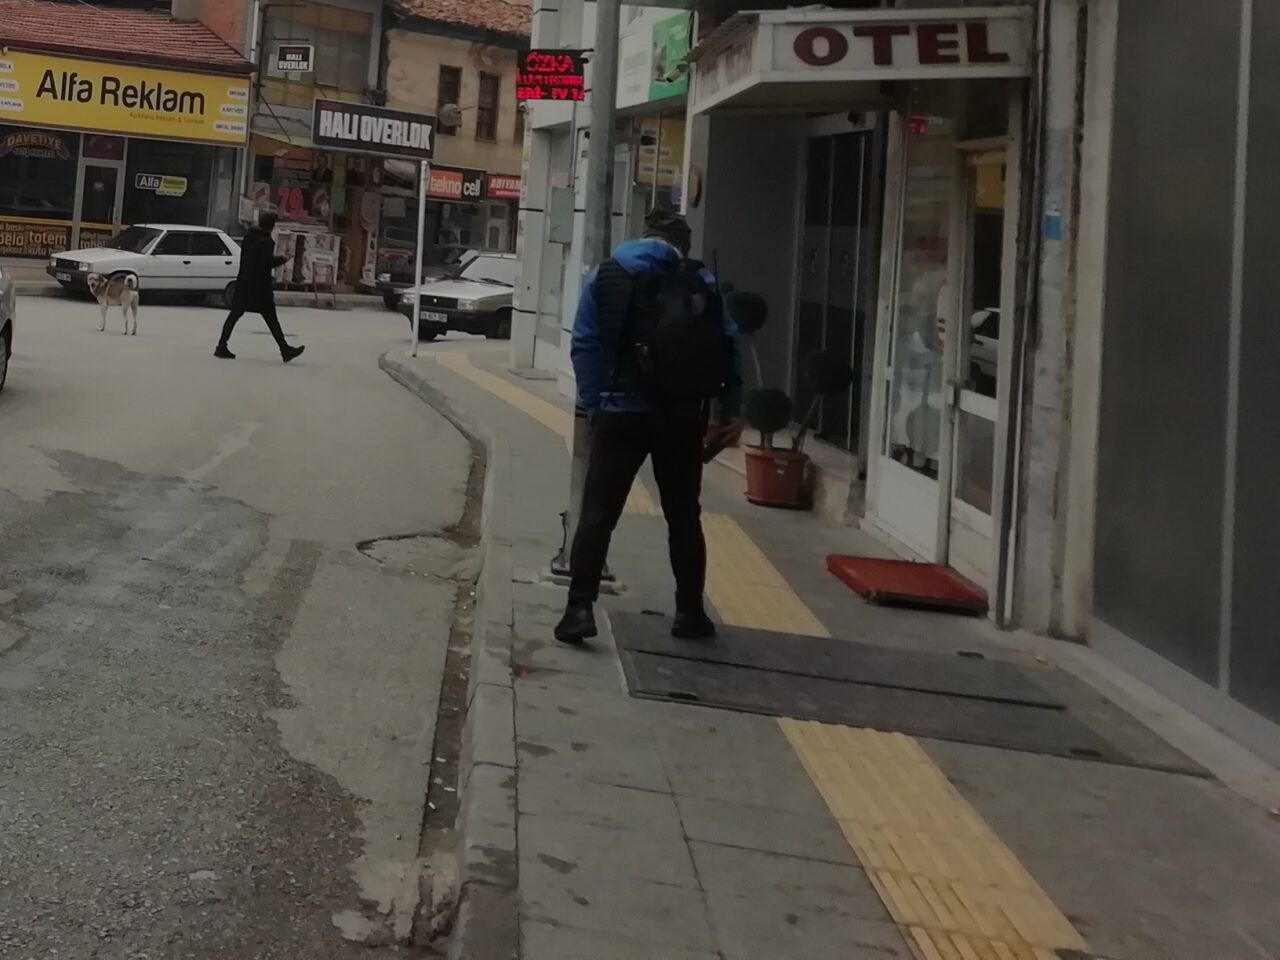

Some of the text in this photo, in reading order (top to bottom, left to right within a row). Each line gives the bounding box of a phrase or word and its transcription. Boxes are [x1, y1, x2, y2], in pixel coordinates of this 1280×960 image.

[793, 23, 1010, 66] OTEL
[35, 69, 205, 115] Alfa Reklam
[319, 110, 432, 150] HALI OVERLOK
[140, 176, 160, 188] Alfa
[29, 230, 67, 245] totem
